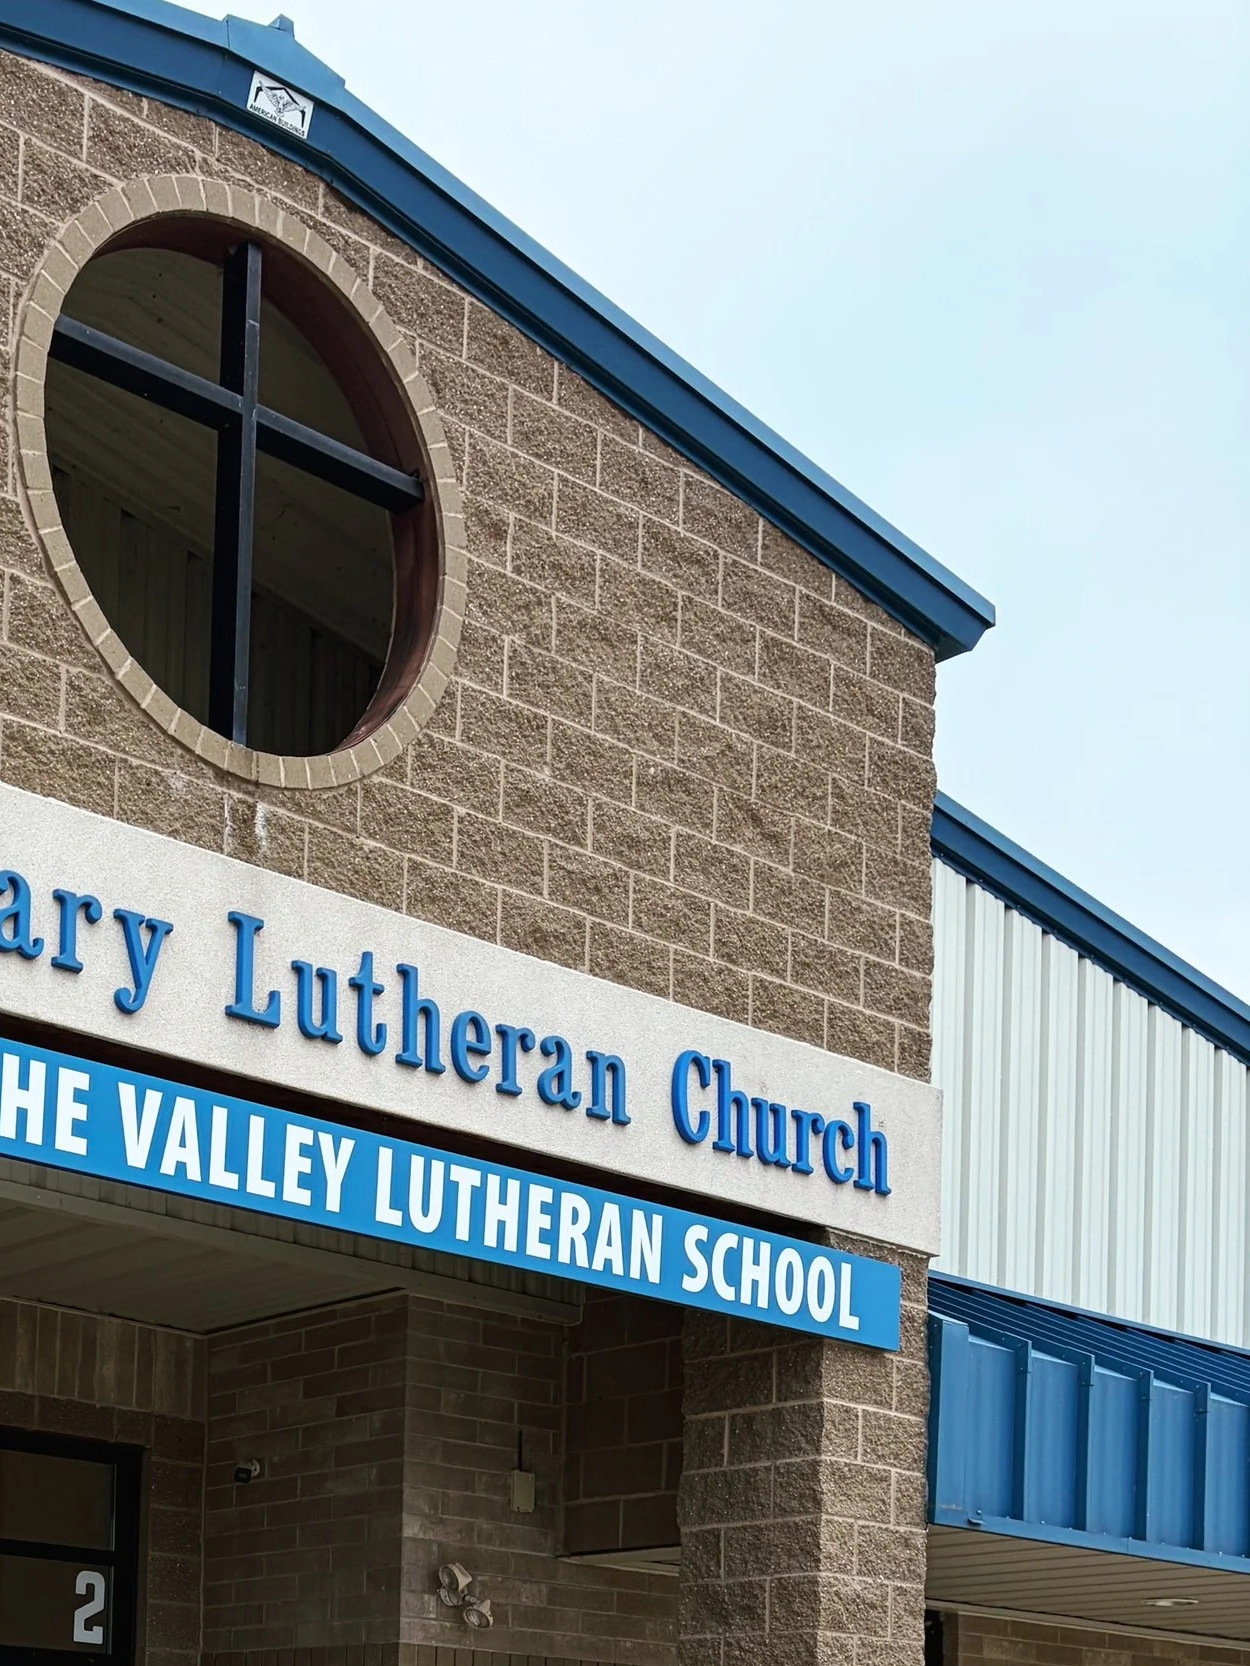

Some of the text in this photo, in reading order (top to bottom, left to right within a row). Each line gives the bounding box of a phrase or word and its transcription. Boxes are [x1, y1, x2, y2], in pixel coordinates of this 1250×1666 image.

[250, 103, 277, 122] AMERICAN
[224, 910, 632, 1127] Lutheran
[671, 1049, 892, 1197] Church
[117, 1081, 357, 1214] VALLEY
[374, 1145, 664, 1285] LUTHERAN
[680, 1223, 860, 1332] SCHOOL
[73, 1570, 106, 1645] 2
